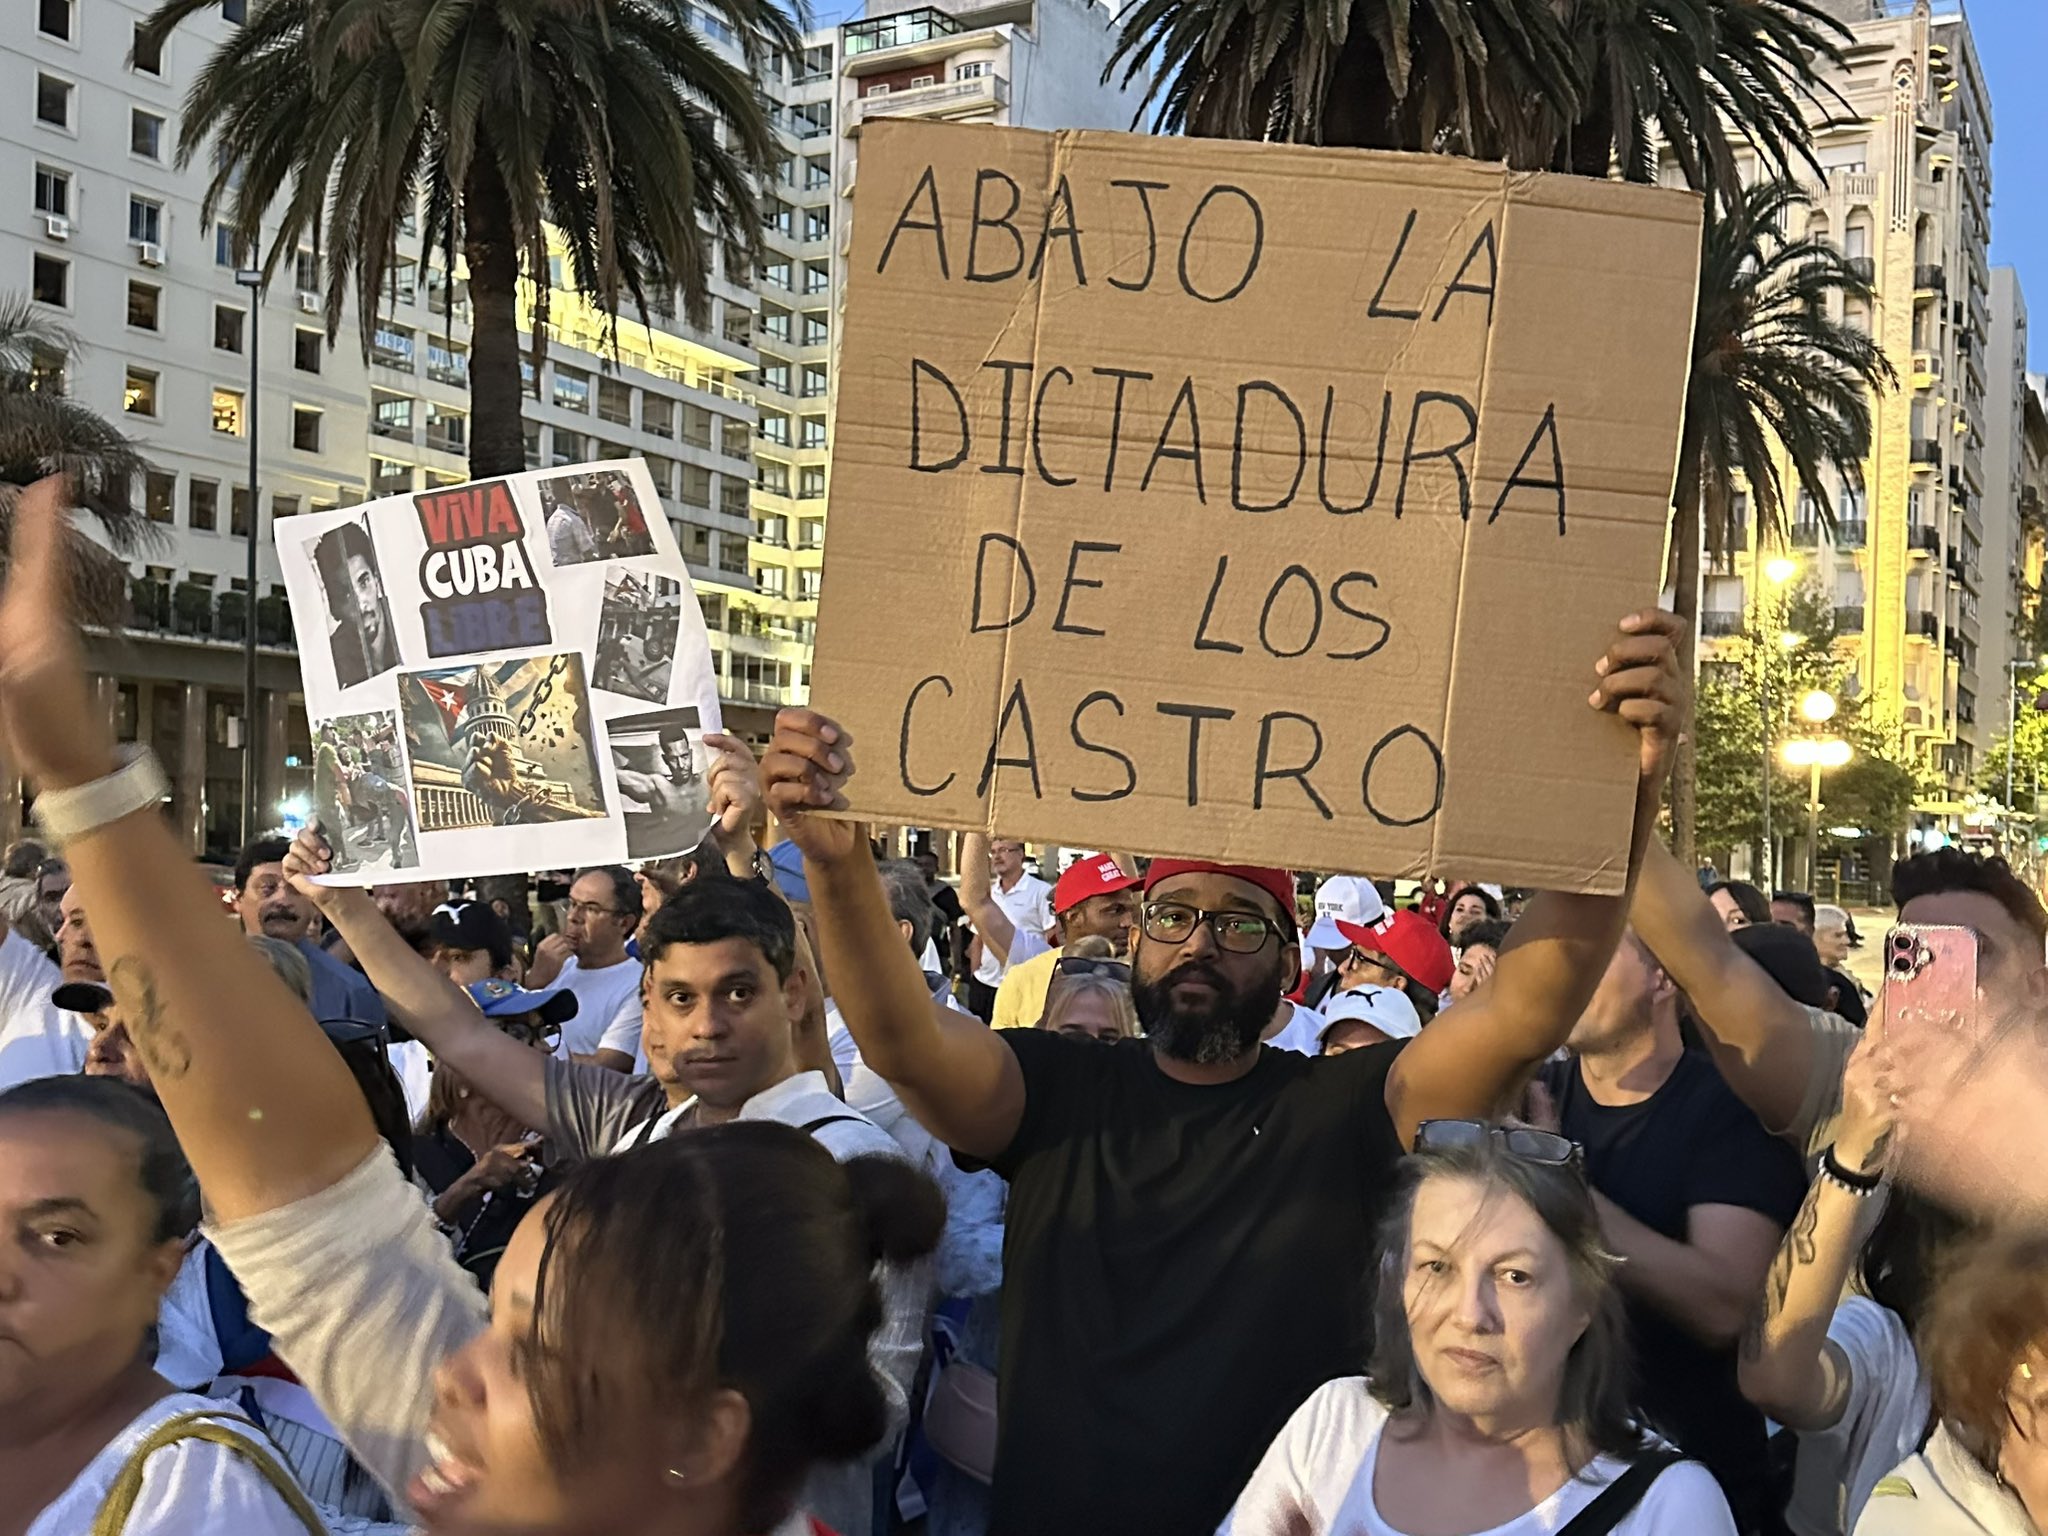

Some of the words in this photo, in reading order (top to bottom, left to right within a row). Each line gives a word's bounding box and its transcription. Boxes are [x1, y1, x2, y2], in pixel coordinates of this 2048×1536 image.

[877, 164, 1265, 303] ABAJO
[1366, 208, 1499, 327] LA
[907, 357, 1567, 537] DICTADURA
[425, 540, 533, 599] CUBA
[426, 597, 547, 654] LIBRE
[970, 532, 1123, 635] DE
[1192, 555, 1392, 661] LOS
[898, 675, 1444, 828] CASTRO
[1326, 902, 1344, 912] YORK
